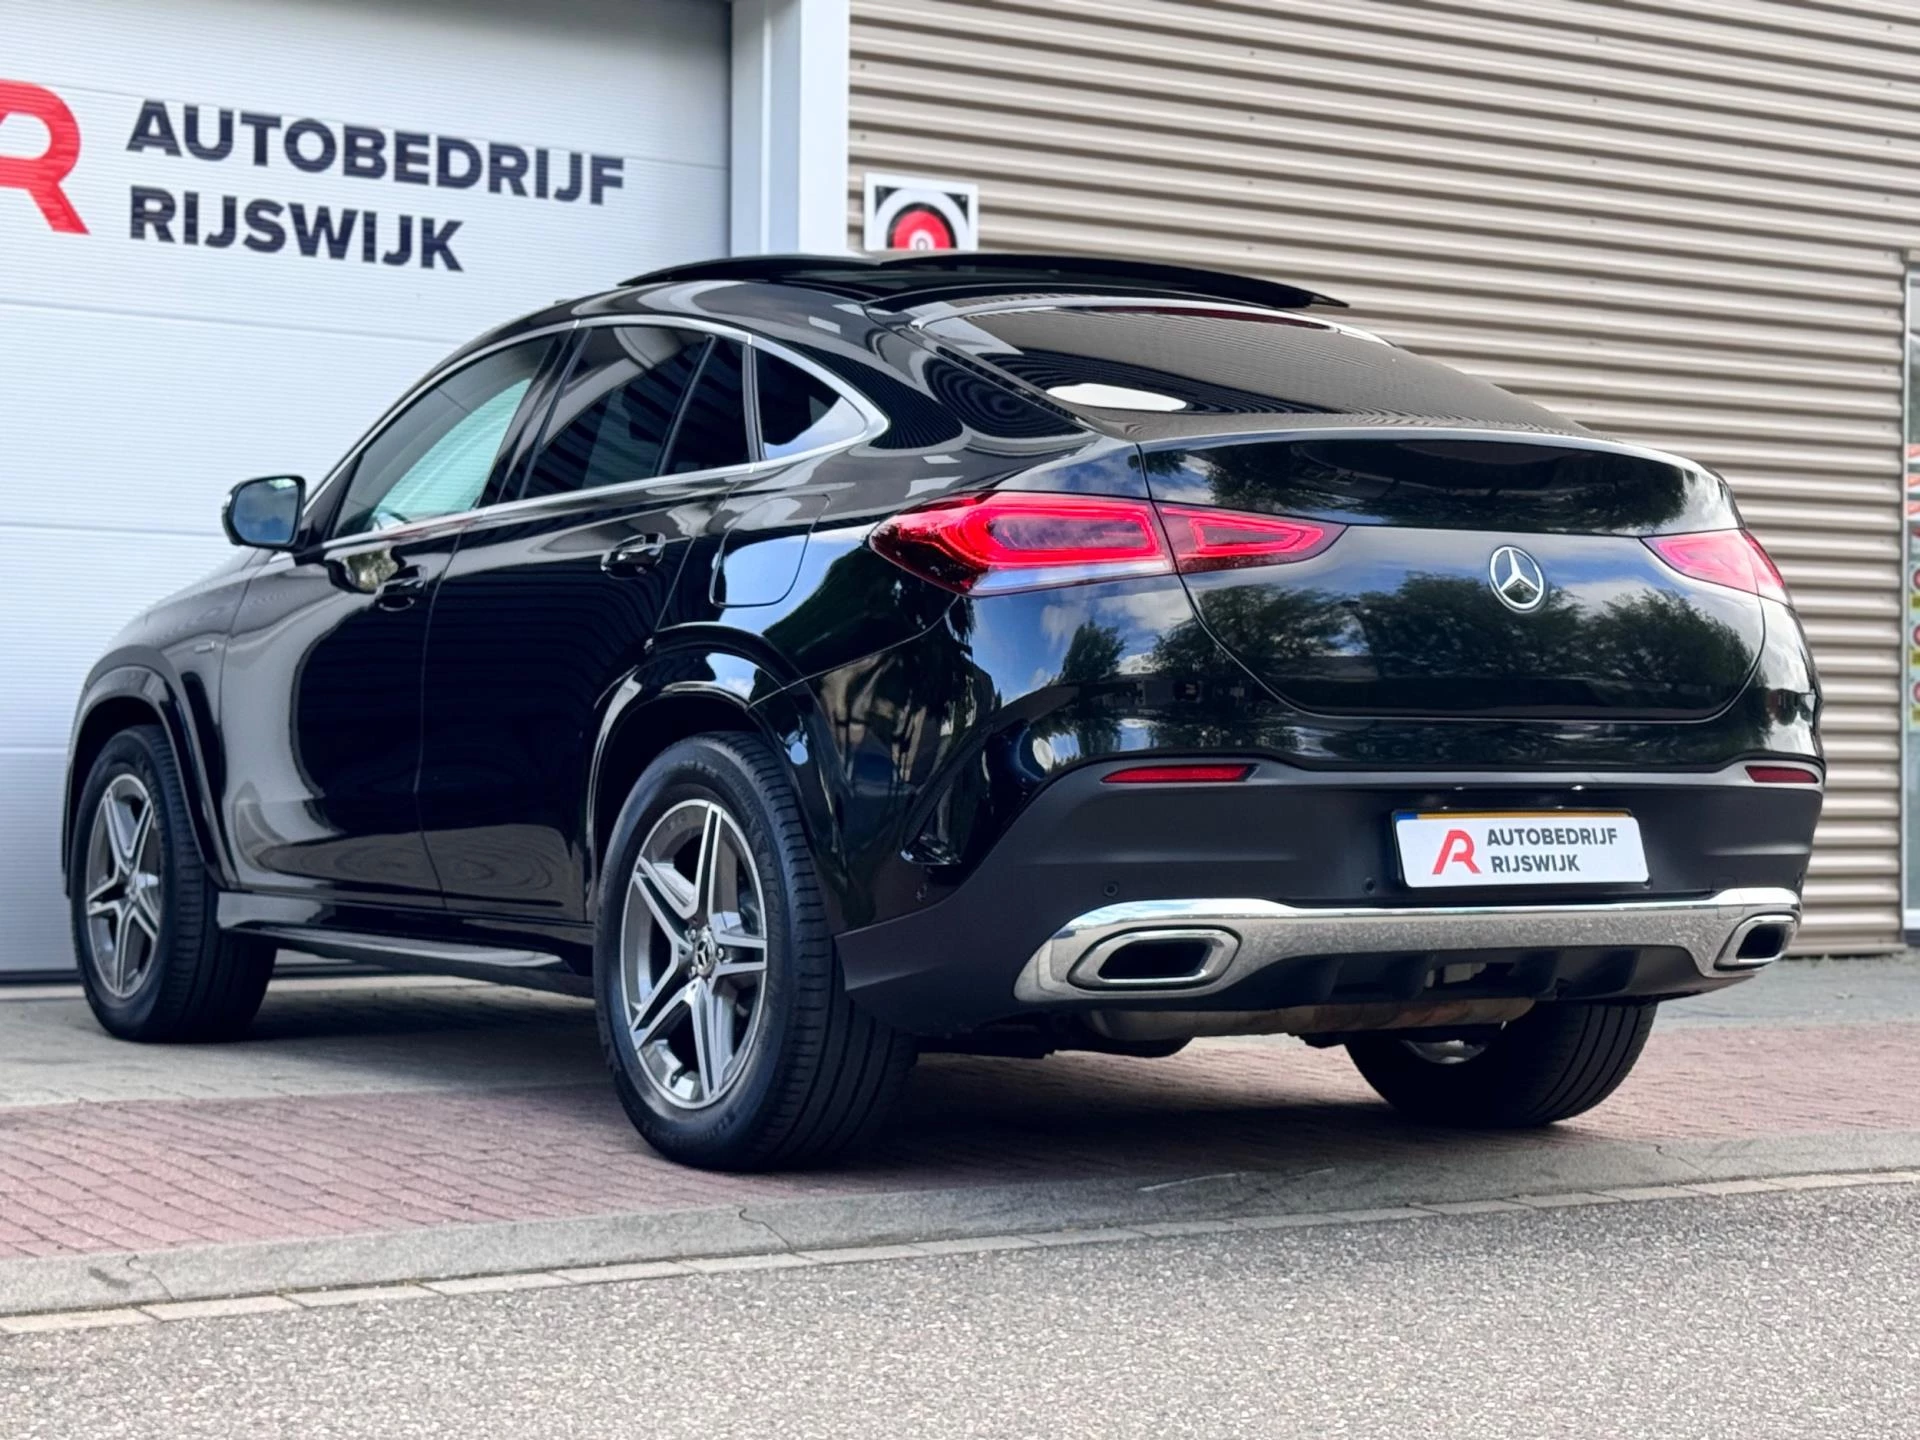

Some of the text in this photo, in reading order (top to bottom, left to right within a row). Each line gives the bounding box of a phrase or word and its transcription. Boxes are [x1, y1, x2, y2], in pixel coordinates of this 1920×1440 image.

[126, 100, 624, 206] AUTOBEDRIJF
[130, 185, 463, 272] RIJSWIJK
[1486, 828, 1618, 846] AUTOBEDRIJF
[1490, 855, 1580, 873] RIJSWIJK
